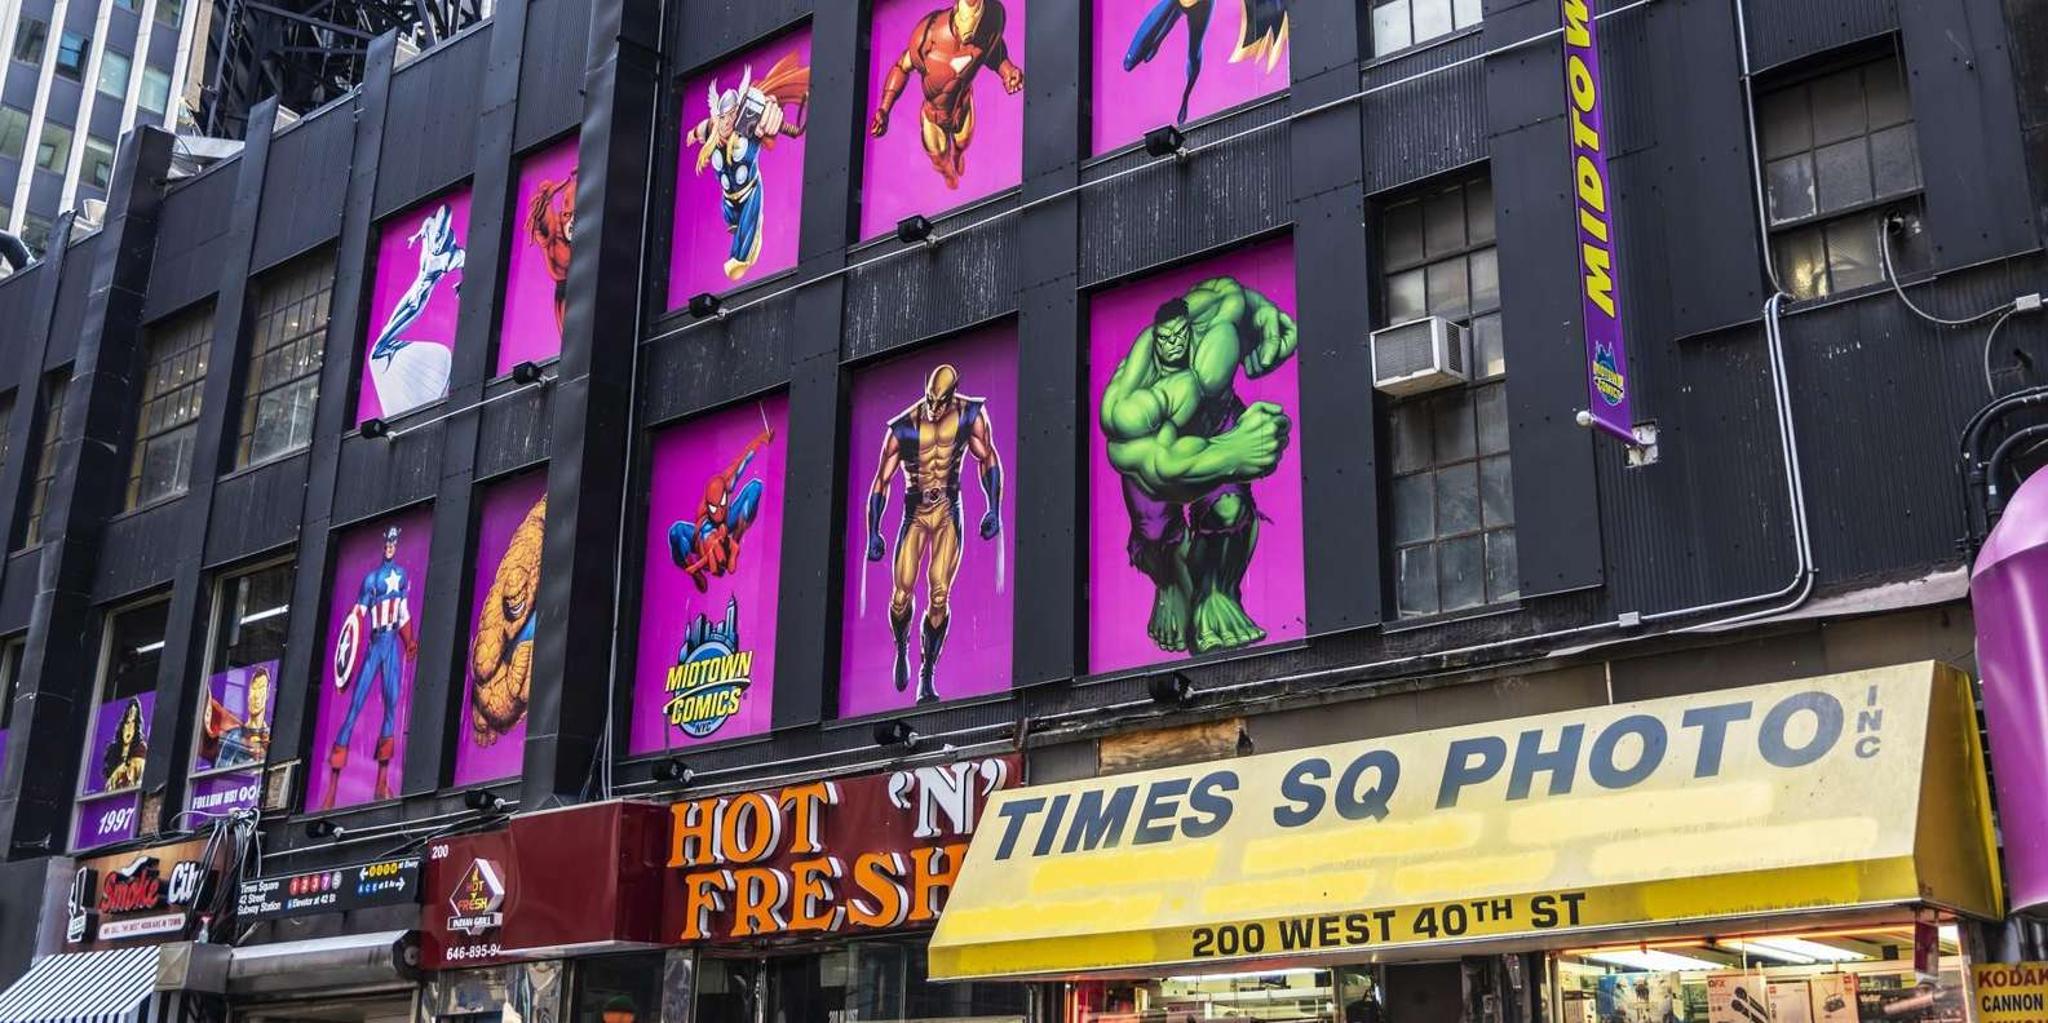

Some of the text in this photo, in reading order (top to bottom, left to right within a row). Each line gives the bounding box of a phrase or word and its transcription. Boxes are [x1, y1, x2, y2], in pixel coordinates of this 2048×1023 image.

[665, 651, 753, 692] MIDTOWN
[671, 687, 742, 726] COMICS
[694, 721, 712, 734] NYC
[1854, 684, 1883, 758] INC
[995, 691, 1844, 861] TIMES SQ PHOTO
[192, 792, 224, 809] FOLLOW
[98, 807, 136, 835] 1997
[667, 781, 838, 868] HOT
[431, 845, 449, 859] 200
[101, 871, 160, 913] Smoke
[241, 881, 280, 893] Times Square
[681, 843, 970, 940] FRESH
[238, 900, 282, 915] Subway Station
[239, 893, 266, 904] 42 Street
[293, 899, 313, 908] Elevator
[321, 895, 329, 903] 42
[457, 898, 488, 911] FRESH
[452, 916, 491, 927] INDIAN GRILL
[1192, 893, 1586, 957] 200 WEST 40TH ST
[1982, 993, 2044, 1013] CANNON
